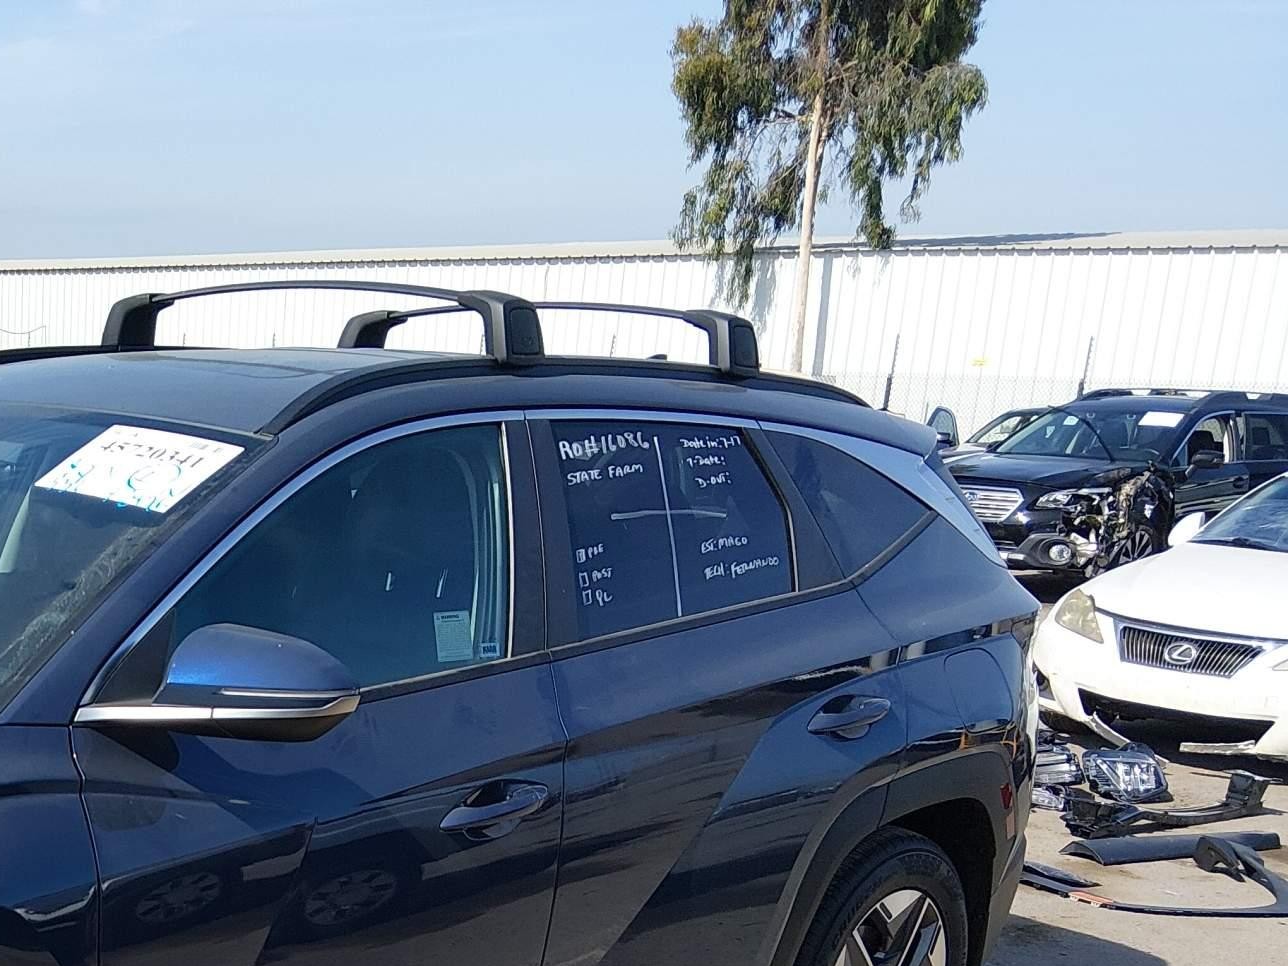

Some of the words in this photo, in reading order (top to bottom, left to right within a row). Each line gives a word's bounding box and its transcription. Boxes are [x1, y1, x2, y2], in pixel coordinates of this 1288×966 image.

[567, 469, 602, 486] STATE
[608, 463, 643, 478] FARM
[730, 556, 780, 579] FERNANDO
